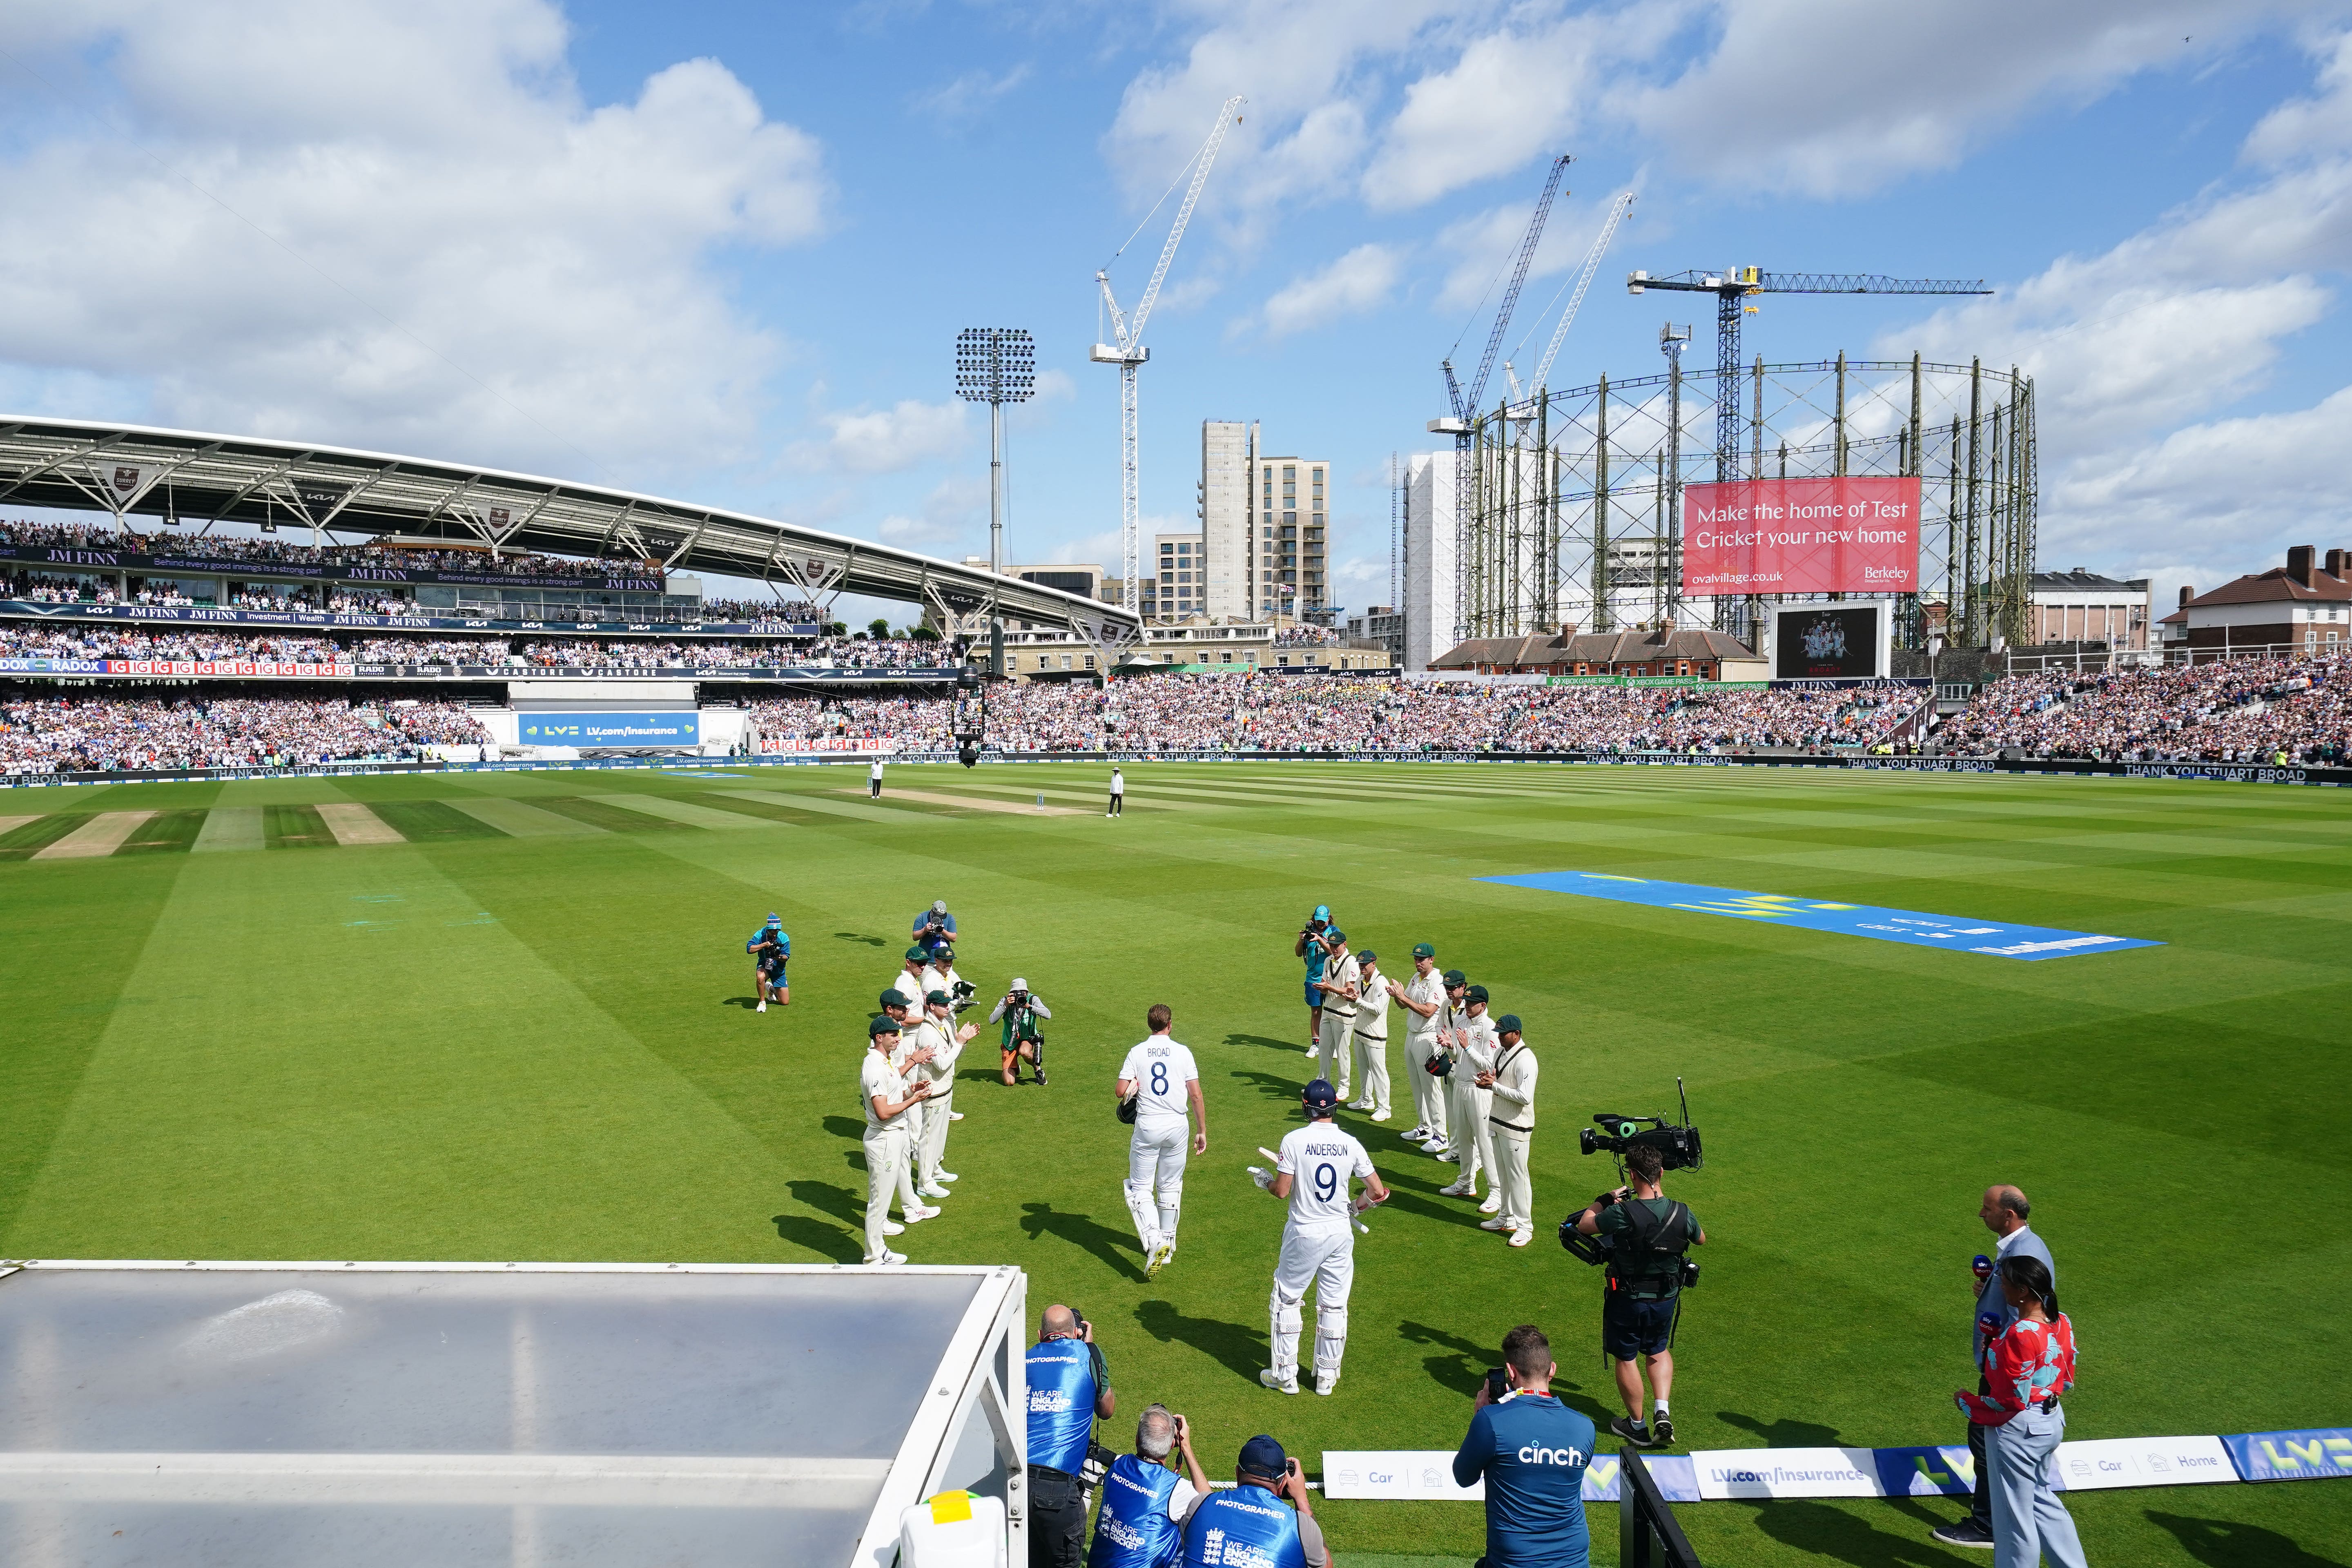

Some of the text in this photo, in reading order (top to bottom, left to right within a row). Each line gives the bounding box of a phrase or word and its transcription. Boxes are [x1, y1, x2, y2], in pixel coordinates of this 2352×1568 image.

[1697, 500, 1908, 523] Make the home of Test
[651, 538, 675, 547] KIA
[1697, 526, 1907, 548] Cricket your new home
[47, 549, 118, 565] JM FINN
[348, 568, 407, 582] JM FINN
[1692, 571, 1783, 585] ovalvillage.co.uk
[1865, 566, 1910, 583] Berkeley
[606, 579, 658, 590] JM FINN
[951, 595, 973, 604] KIA
[129, 608, 178, 618] JM FINN
[190, 610, 237, 620] JM FINN
[247, 613, 290, 621] Investment
[388, 618, 430, 627] JM FINN
[749, 625, 794, 633] JM FINN
[0, 660, 29, 670] DOX
[52, 661, 99, 671] RADOX
[111, 661, 126, 673] IG
[154, 662, 169, 673] IG
[198, 662, 212, 674] IG
[239, 663, 253, 674] IG
[319, 665, 333, 675] IG
[339, 665, 351, 674] IG
[1809, 681, 1837, 689] FINN
[587, 727, 678, 736] LV.com/insurance
[765, 741, 776, 749] IG
[782, 741, 793, 749] IG
[864, 740, 876, 749] IG
[881, 741, 892, 749] IG
[1846, 759, 1995, 770] THANK YOU STUART BROAD
[212, 765, 380, 778] THANK YOU STUART BROAD
[2125, 765, 2306, 781] THANK YOU STUART BROAD
[22, 774, 70, 784] BROAD
[1147, 1047, 1170, 1057] BROAD
[1151, 1062, 1169, 1096] 8
[1305, 1143, 1348, 1156] ANDERSON
[1315, 1162, 1337, 1203] 9
[1031, 1397, 1071, 1406] ENGLAND
[1030, 1404, 1066, 1412] CRICKET
[1518, 1440, 1582, 1466] cinch
[2098, 1454, 2218, 1472] Car Home
[1369, 1472, 1393, 1484] Car
[1712, 1465, 1865, 1485] LV.com/insurance
[1111, 1472, 1159, 1499] PHOTOGRAPHER
[1215, 1499, 1285, 1520] PHOTOGRAPHER
[1112, 1517, 1138, 1536] WE ARE
[1110, 1524, 1145, 1545] ENGLAND
[1109, 1532, 1139, 1551] CRICKET
[1226, 1540, 1266, 1557] WE ARE
[1224, 1547, 1275, 1568] ENGLAND
